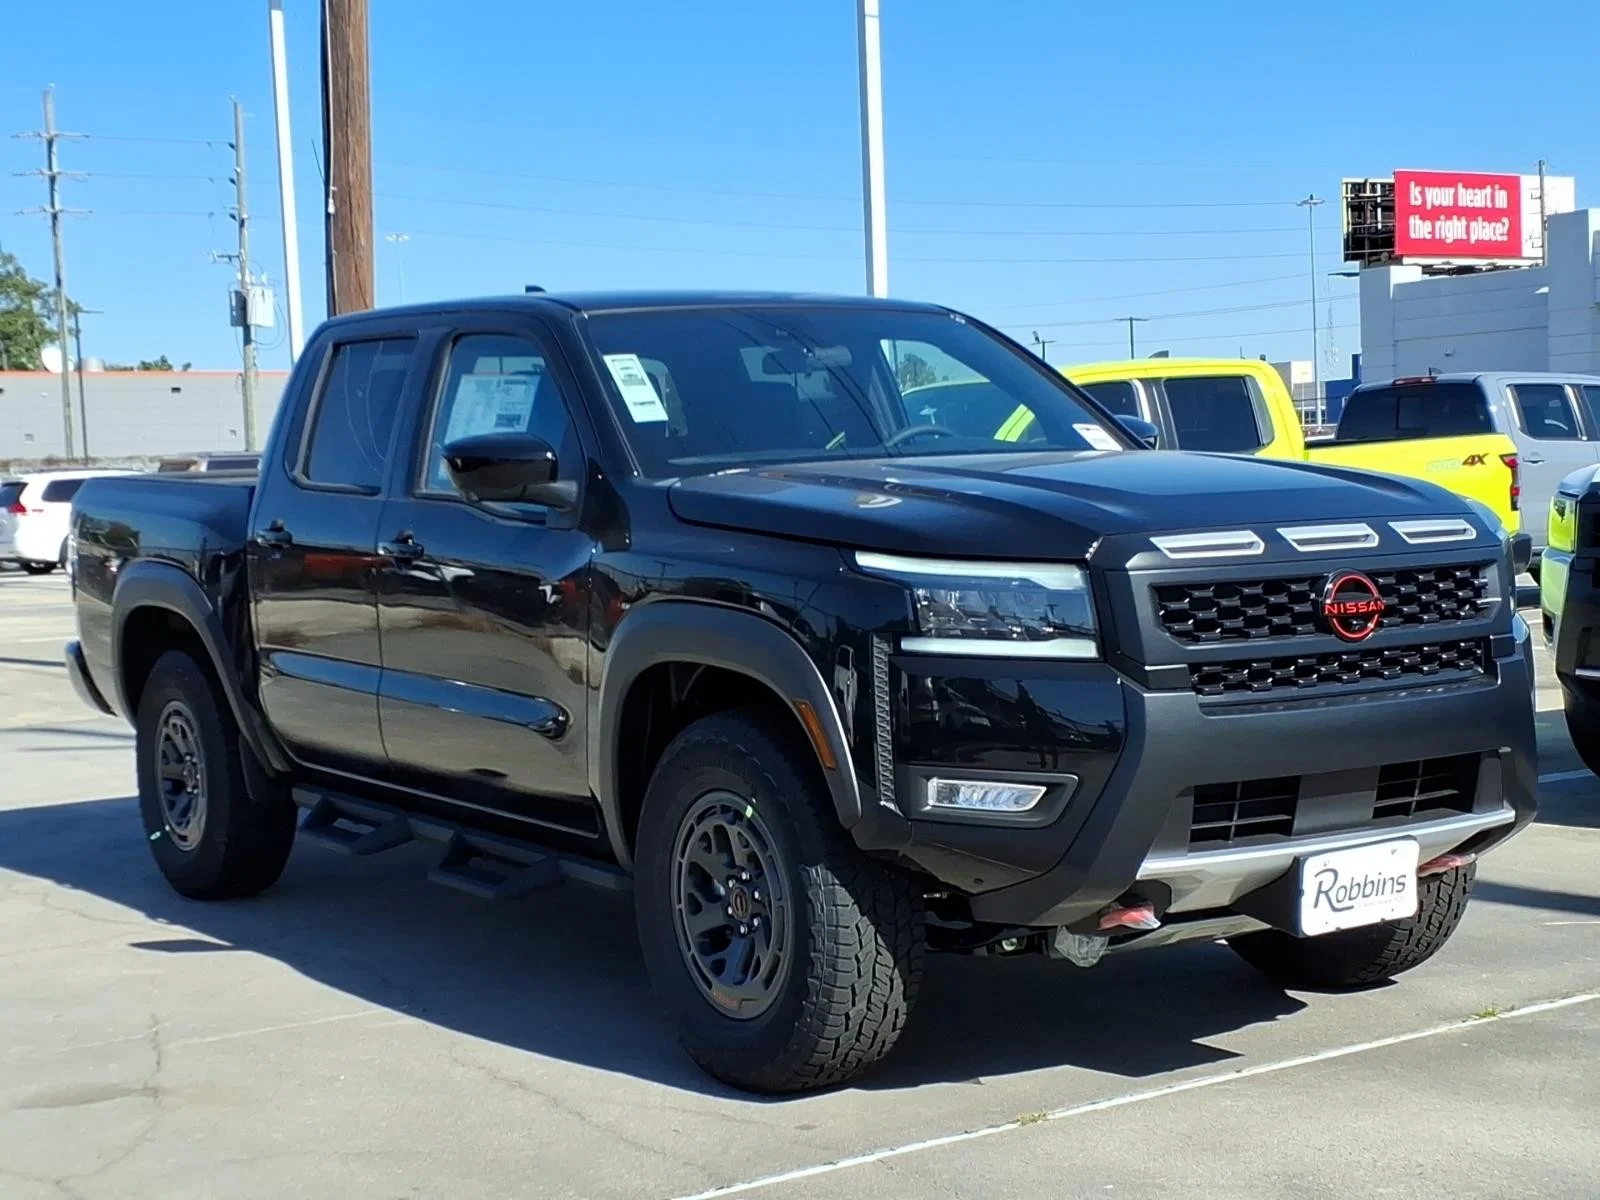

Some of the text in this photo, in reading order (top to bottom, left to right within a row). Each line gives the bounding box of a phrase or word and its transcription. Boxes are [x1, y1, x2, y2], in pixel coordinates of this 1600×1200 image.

[1409, 180, 1508, 210] Is your heart in
[1409, 214, 1510, 244] the right place?
[1325, 600, 1385, 615] NISSAN
[1313, 867, 1407, 913] Robbins
